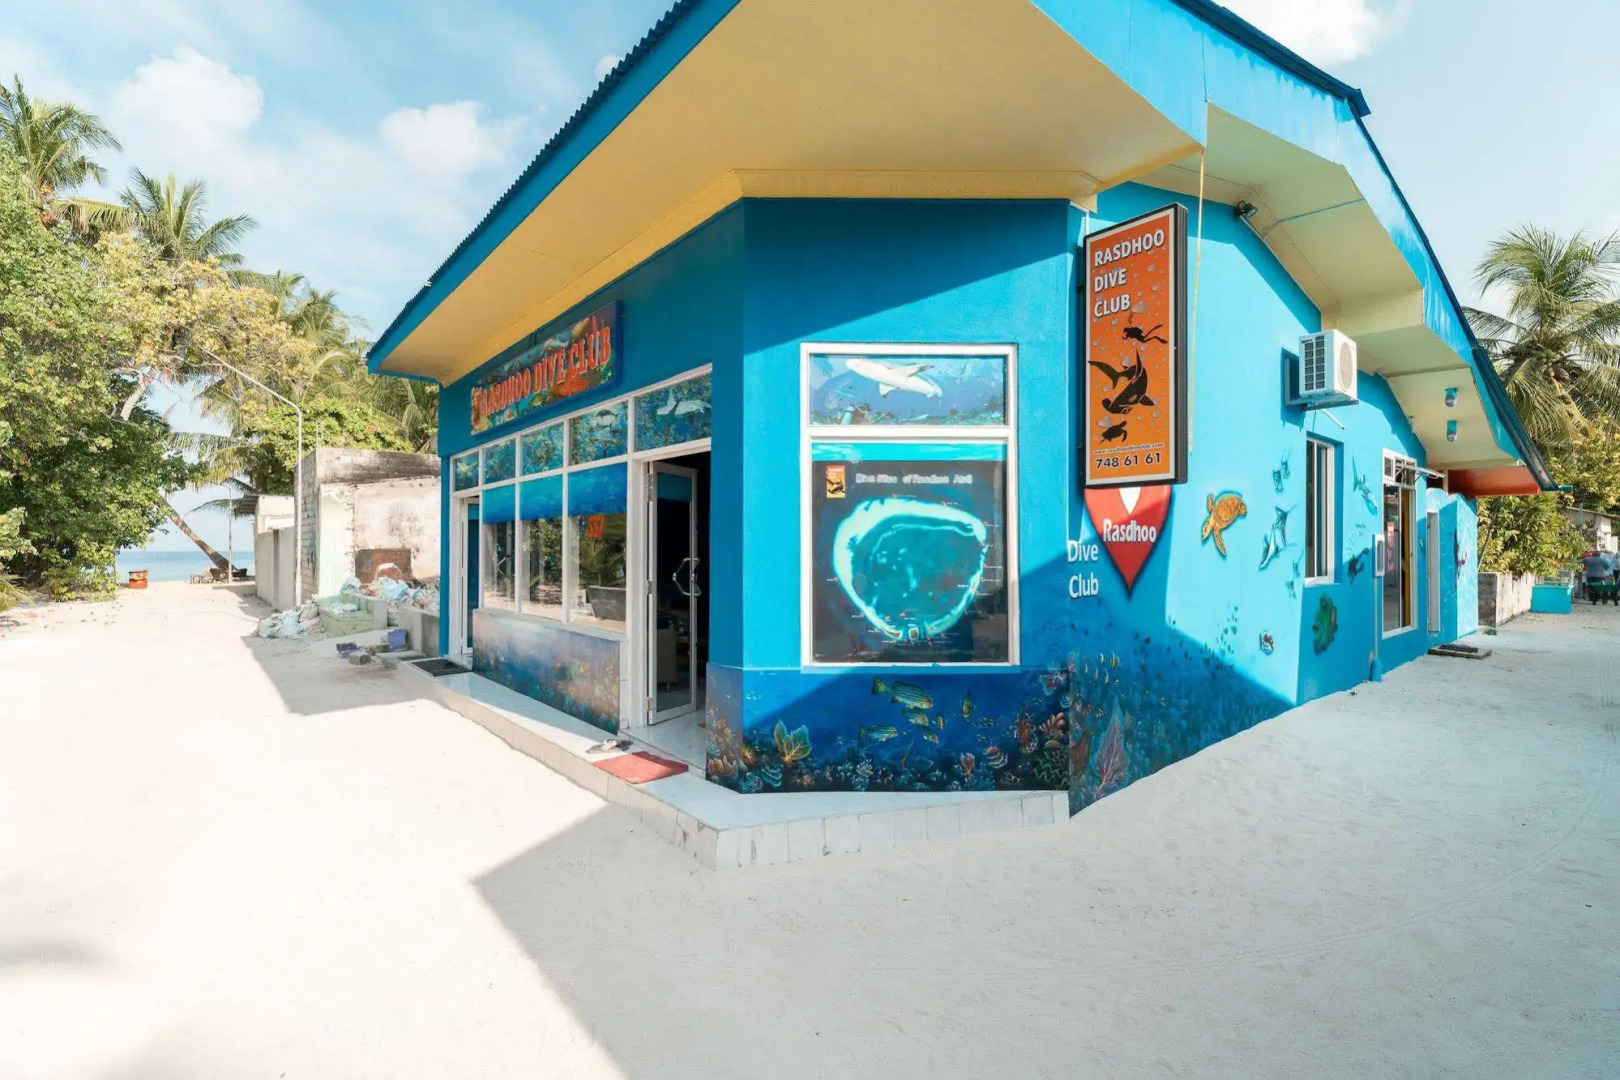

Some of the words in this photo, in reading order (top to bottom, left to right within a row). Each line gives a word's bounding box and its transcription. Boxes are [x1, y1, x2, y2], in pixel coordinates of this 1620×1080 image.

[1094, 229, 1165, 267] RASDHOO
[1094, 268, 1127, 292] DIVE
[1094, 294, 1131, 318] CLUB
[480, 368, 531, 417] RASDHOO
[533, 347, 567, 394] DIVE
[567, 326, 612, 379] CLUB
[1095, 457, 1119, 469] 748
[1124, 455, 1139, 467] 61
[1145, 452, 1161, 464] 61
[1103, 518, 1157, 542] Rasdhoo
[1067, 538, 1099, 563] Dive
[1068, 573, 1099, 598] Club
